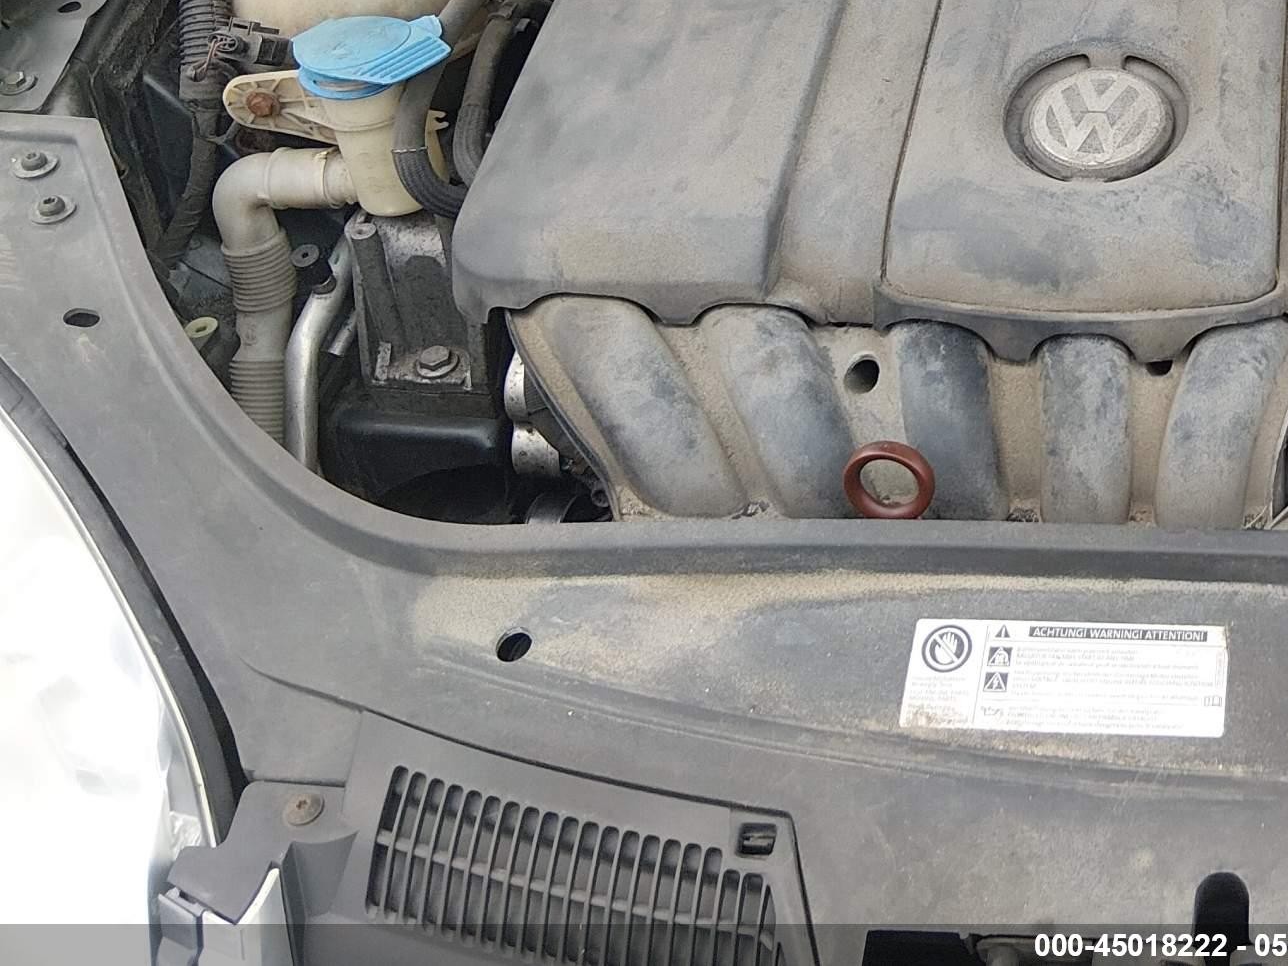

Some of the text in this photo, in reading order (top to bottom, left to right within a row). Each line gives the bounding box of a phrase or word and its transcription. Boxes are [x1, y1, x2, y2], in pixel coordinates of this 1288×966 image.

[1033, 627, 1204, 641] ACHTUNG! WARNING! ATTENTION!
